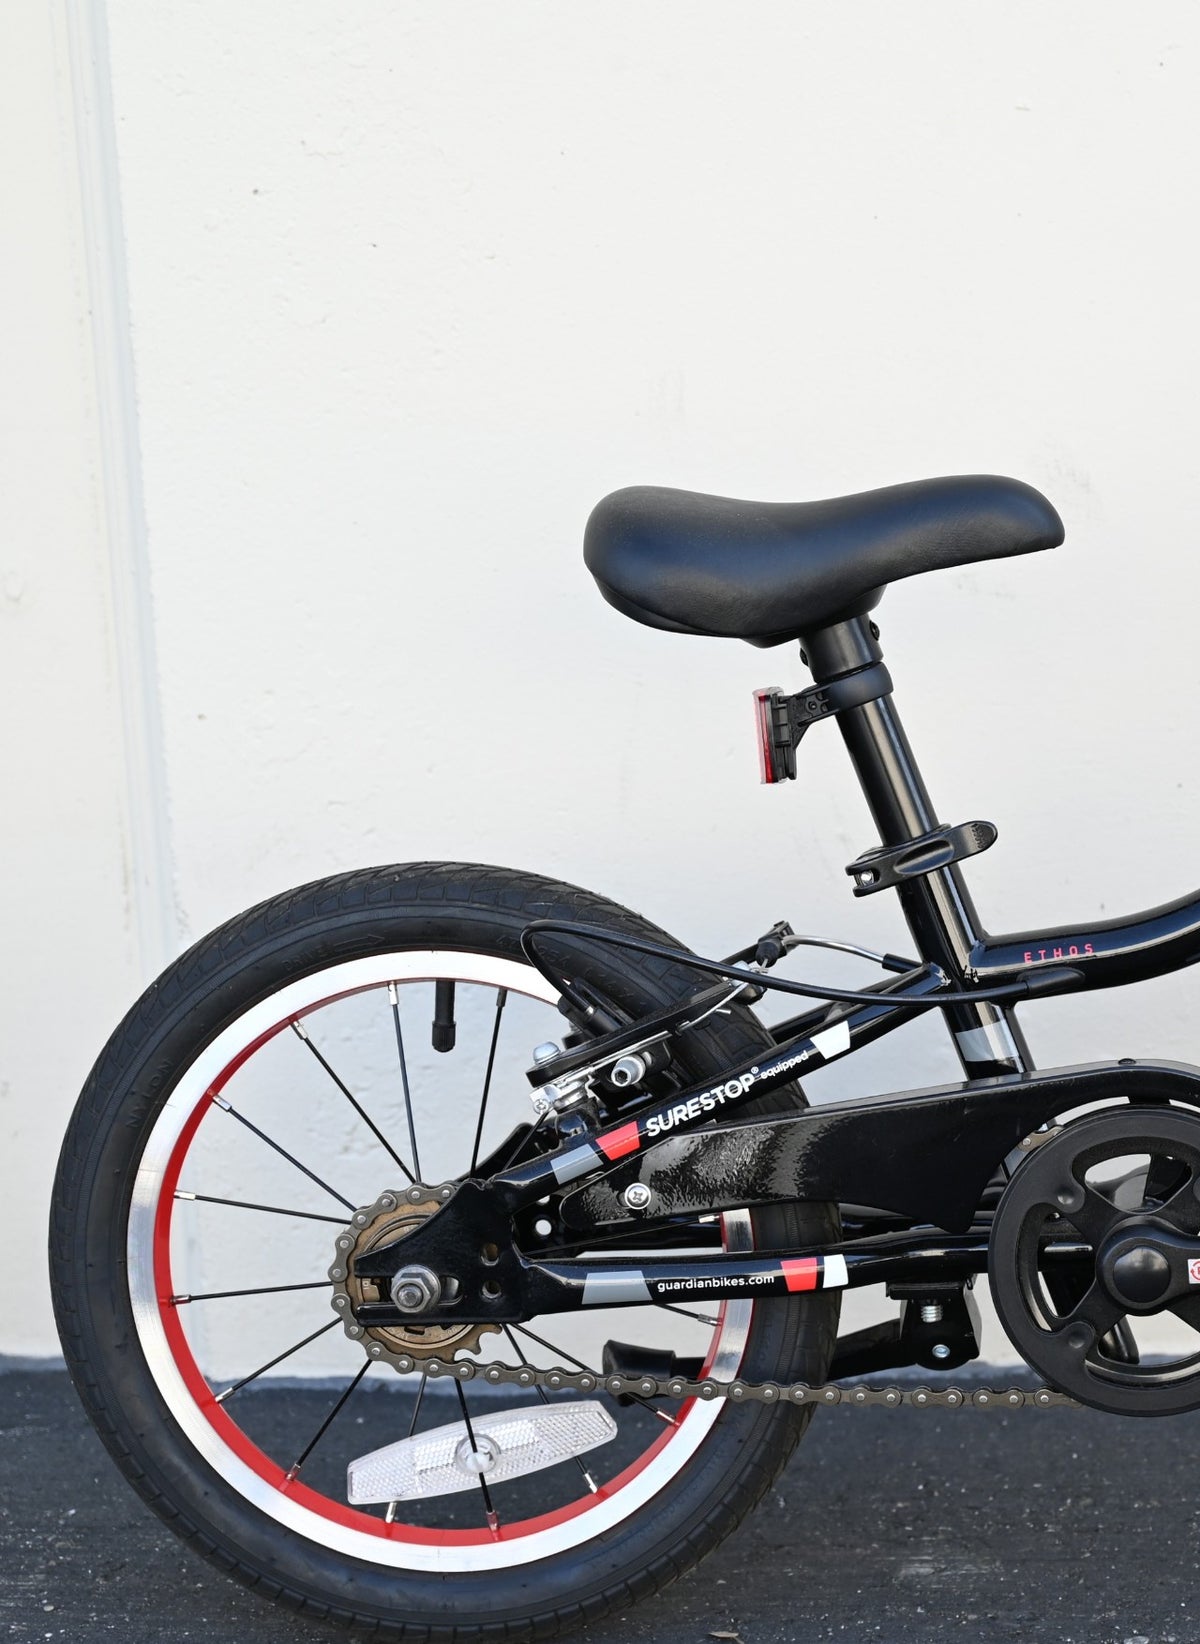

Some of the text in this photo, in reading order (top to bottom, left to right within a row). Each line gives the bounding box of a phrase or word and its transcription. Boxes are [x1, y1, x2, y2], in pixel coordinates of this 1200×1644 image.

[1023, 943, 1094, 964] ETHOS
[760, 1049, 809, 1080] equipped
[657, 1275, 775, 1293] guardianbikes.com
